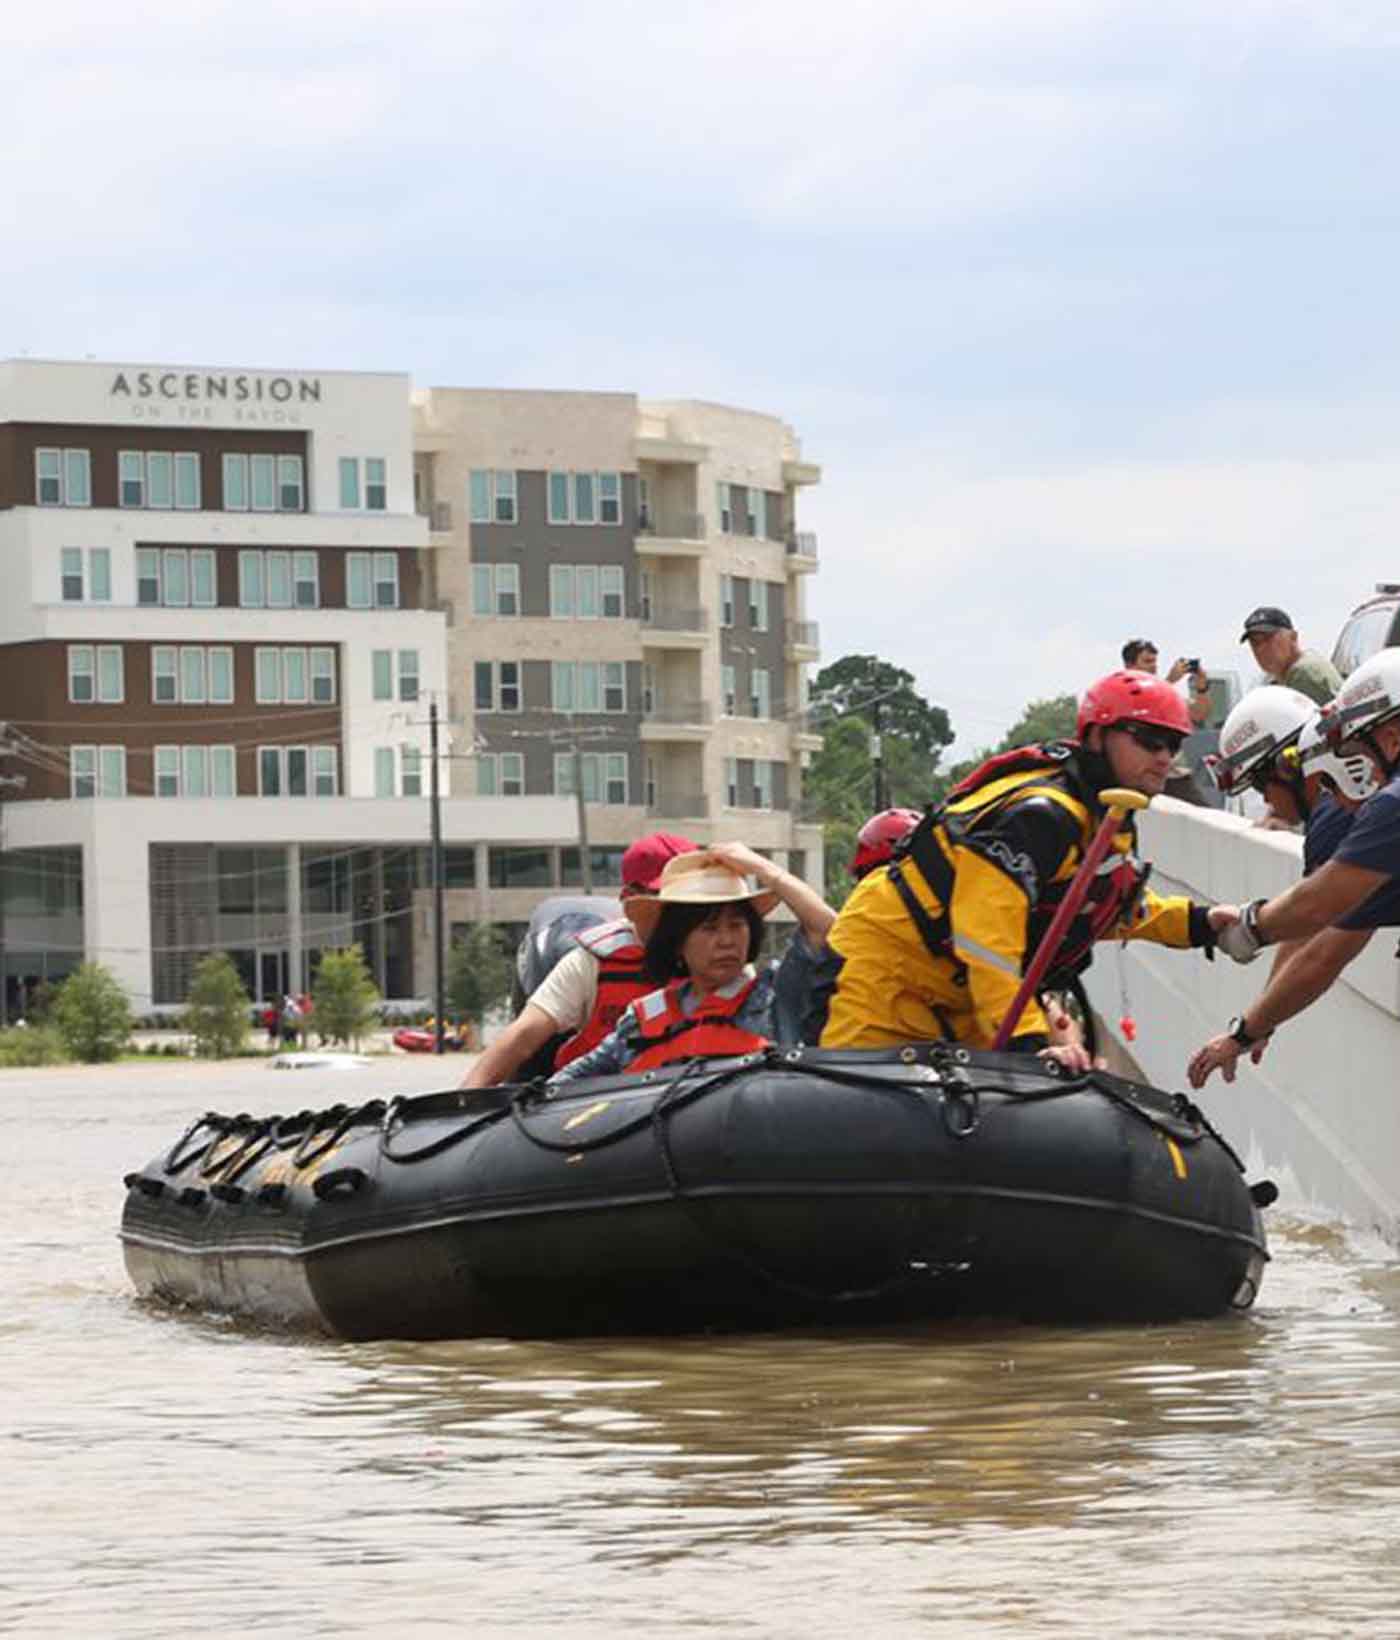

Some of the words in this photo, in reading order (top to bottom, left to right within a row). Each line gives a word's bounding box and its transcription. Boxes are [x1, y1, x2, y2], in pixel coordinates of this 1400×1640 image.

[111, 372, 321, 402] ASCENSION
[132, 404, 161, 418] ON
[177, 405, 213, 420] THE
[234, 406, 303, 423] BAYOU
